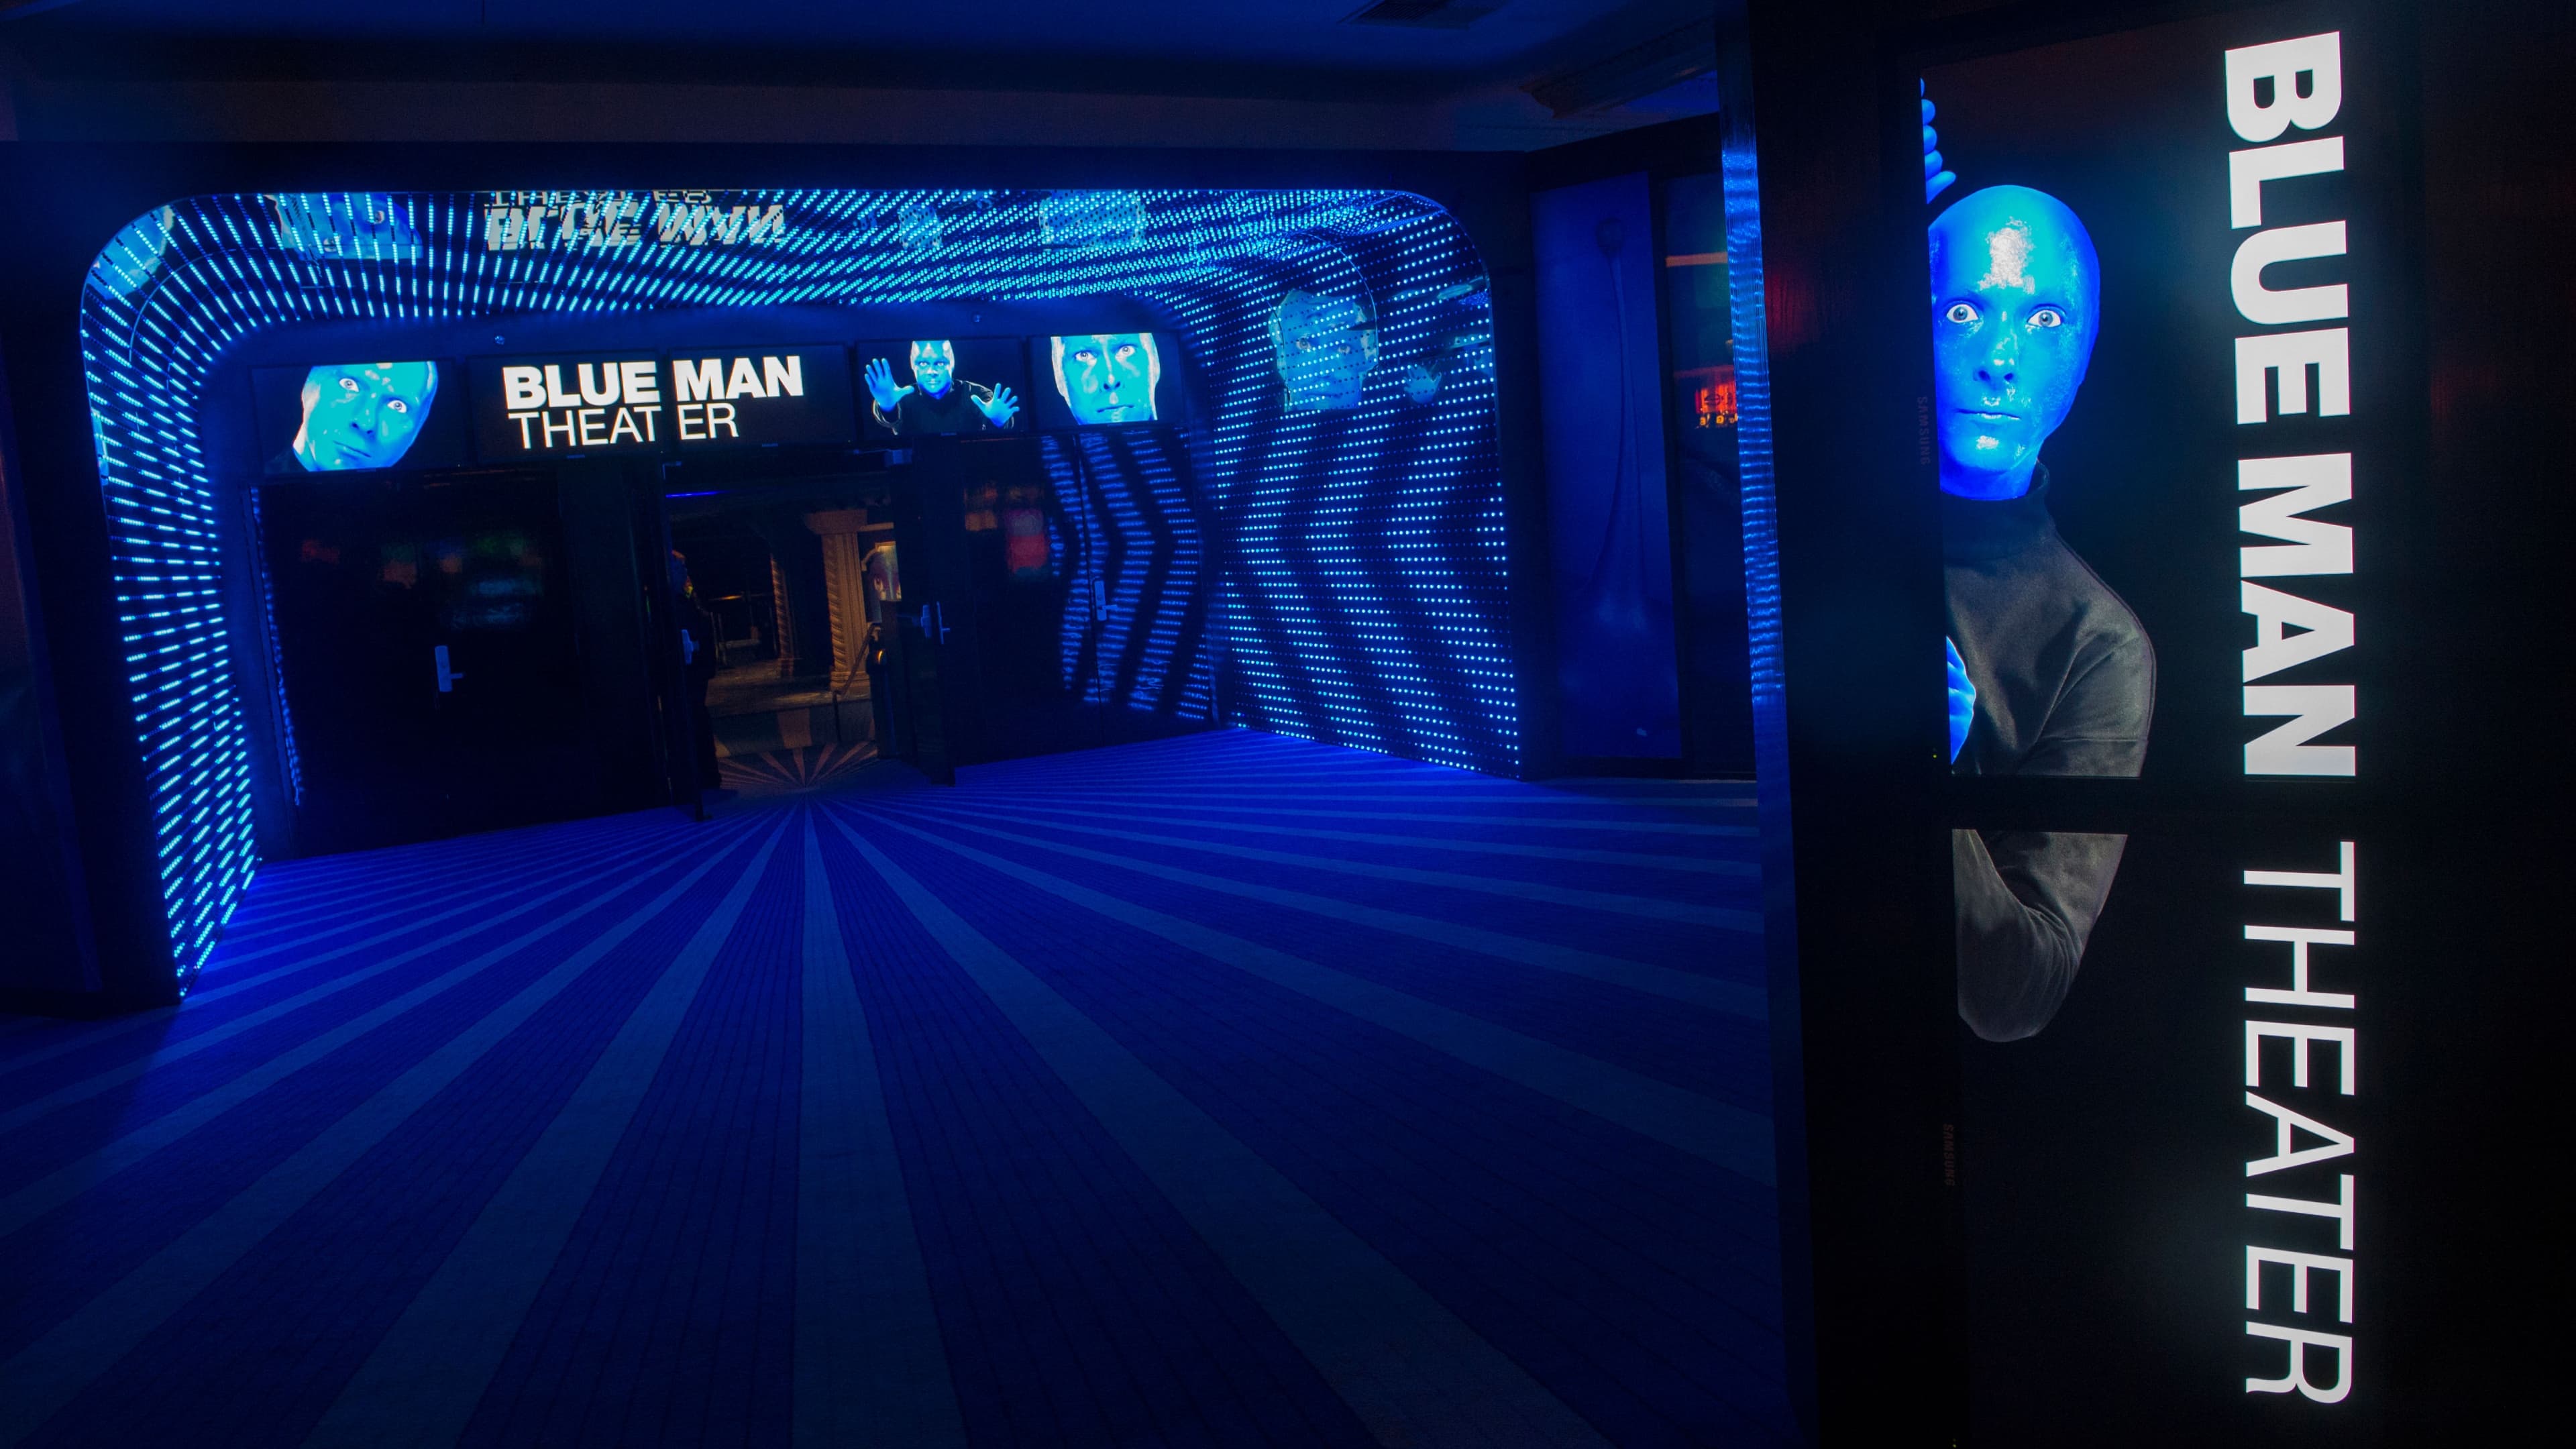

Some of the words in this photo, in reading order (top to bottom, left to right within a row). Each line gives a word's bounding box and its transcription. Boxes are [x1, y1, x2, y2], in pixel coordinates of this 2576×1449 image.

[2224, 31, 2351, 425] BLUE
[502, 361, 660, 410] BLUE
[673, 355, 804, 402] MAN
[1917, 396, 1931, 466] SAMSUNG
[2237, 452, 2356, 776] MAN
[1943, 1122, 1954, 1187] SAMSUNG
[2243, 841, 2355, 1404] THEATER
